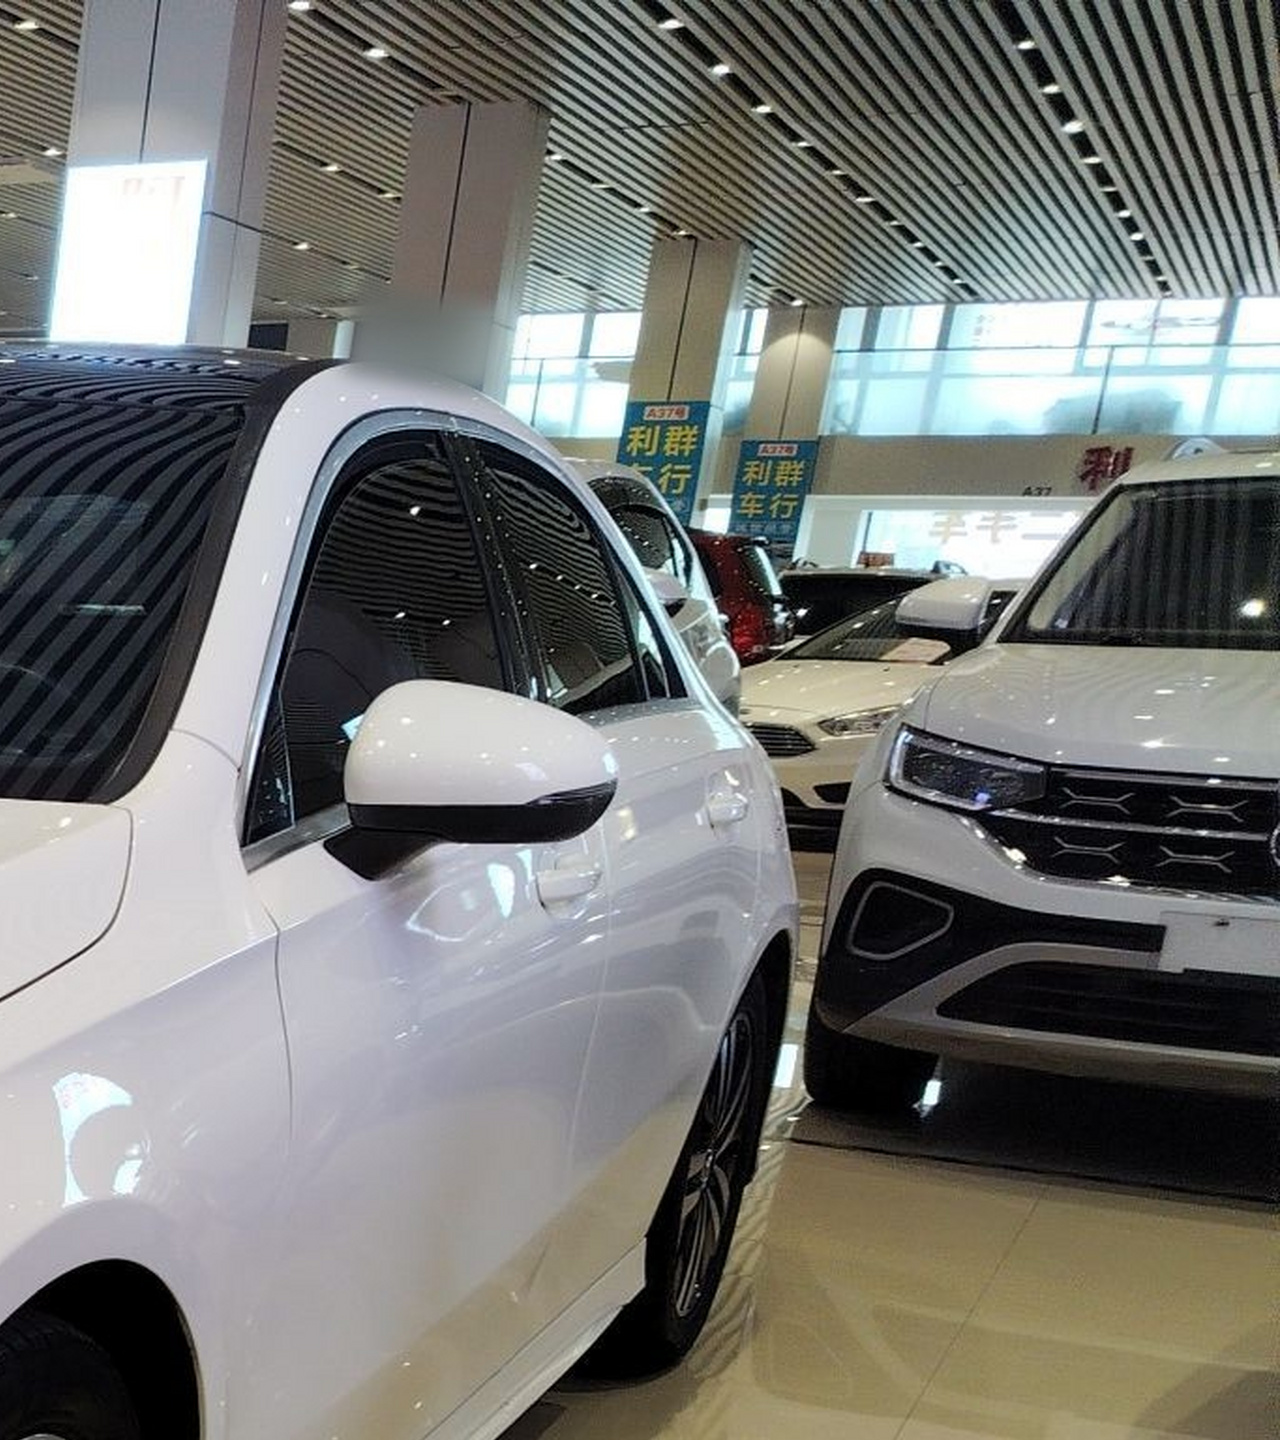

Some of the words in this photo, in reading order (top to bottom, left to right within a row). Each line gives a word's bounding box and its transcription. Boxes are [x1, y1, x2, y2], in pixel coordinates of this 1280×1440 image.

[627, 425, 698, 457] 利群
[743, 460, 805, 487] 利群
[737, 492, 799, 518] 车行
